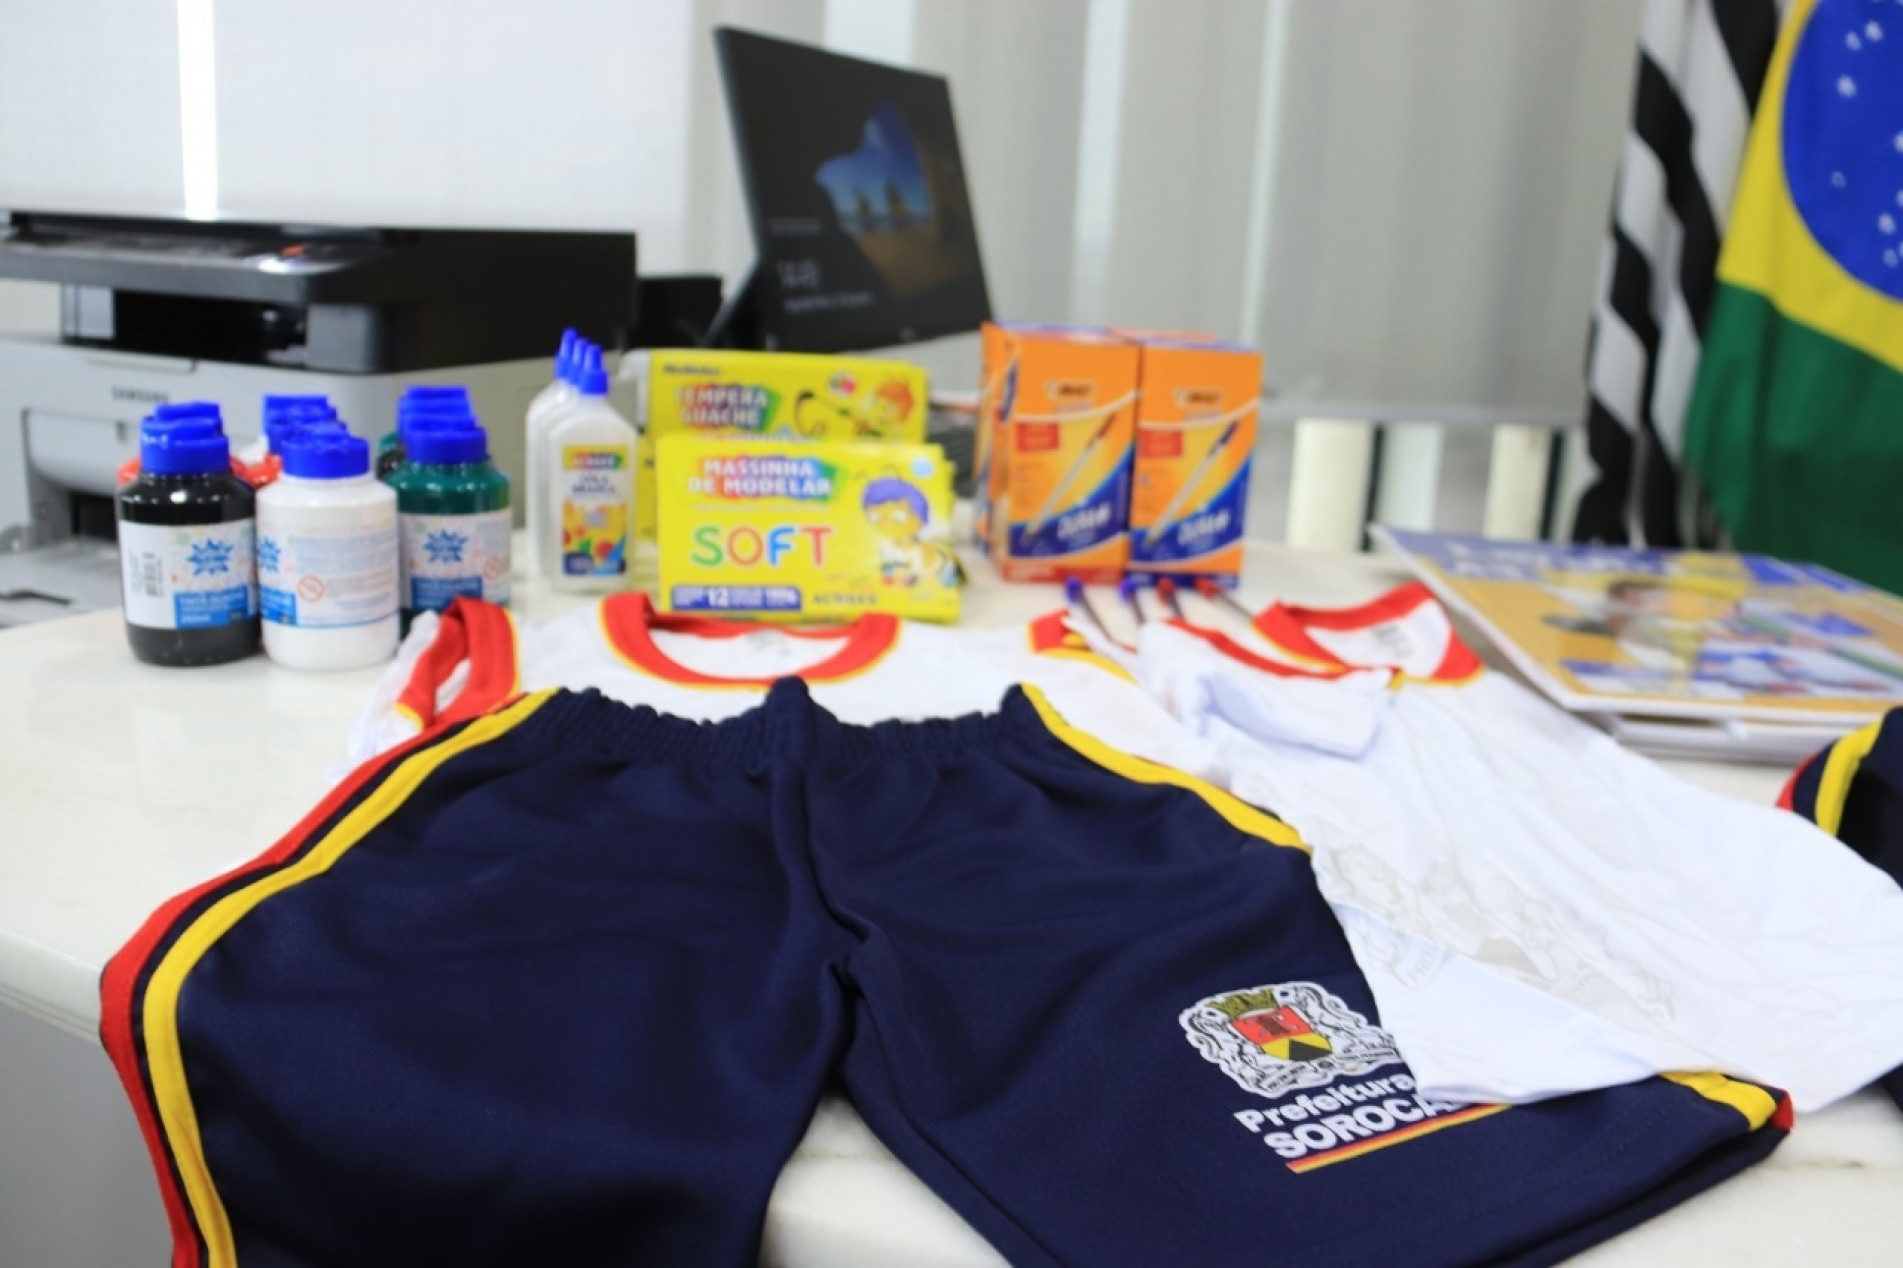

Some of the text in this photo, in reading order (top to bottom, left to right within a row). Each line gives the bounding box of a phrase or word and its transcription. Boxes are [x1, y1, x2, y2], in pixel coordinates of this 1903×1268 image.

[674, 385, 768, 406] TEMPERA
[680, 406, 759, 425] GUACHE
[703, 458, 815, 477] MASSINHA
[687, 477, 831, 494] DE MODELAR
[690, 526, 833, 568] SOFT
[708, 585, 728, 606] 12
[1233, 1074, 1416, 1133] Prefeitura
[1263, 1093, 1463, 1159] SOROCA
